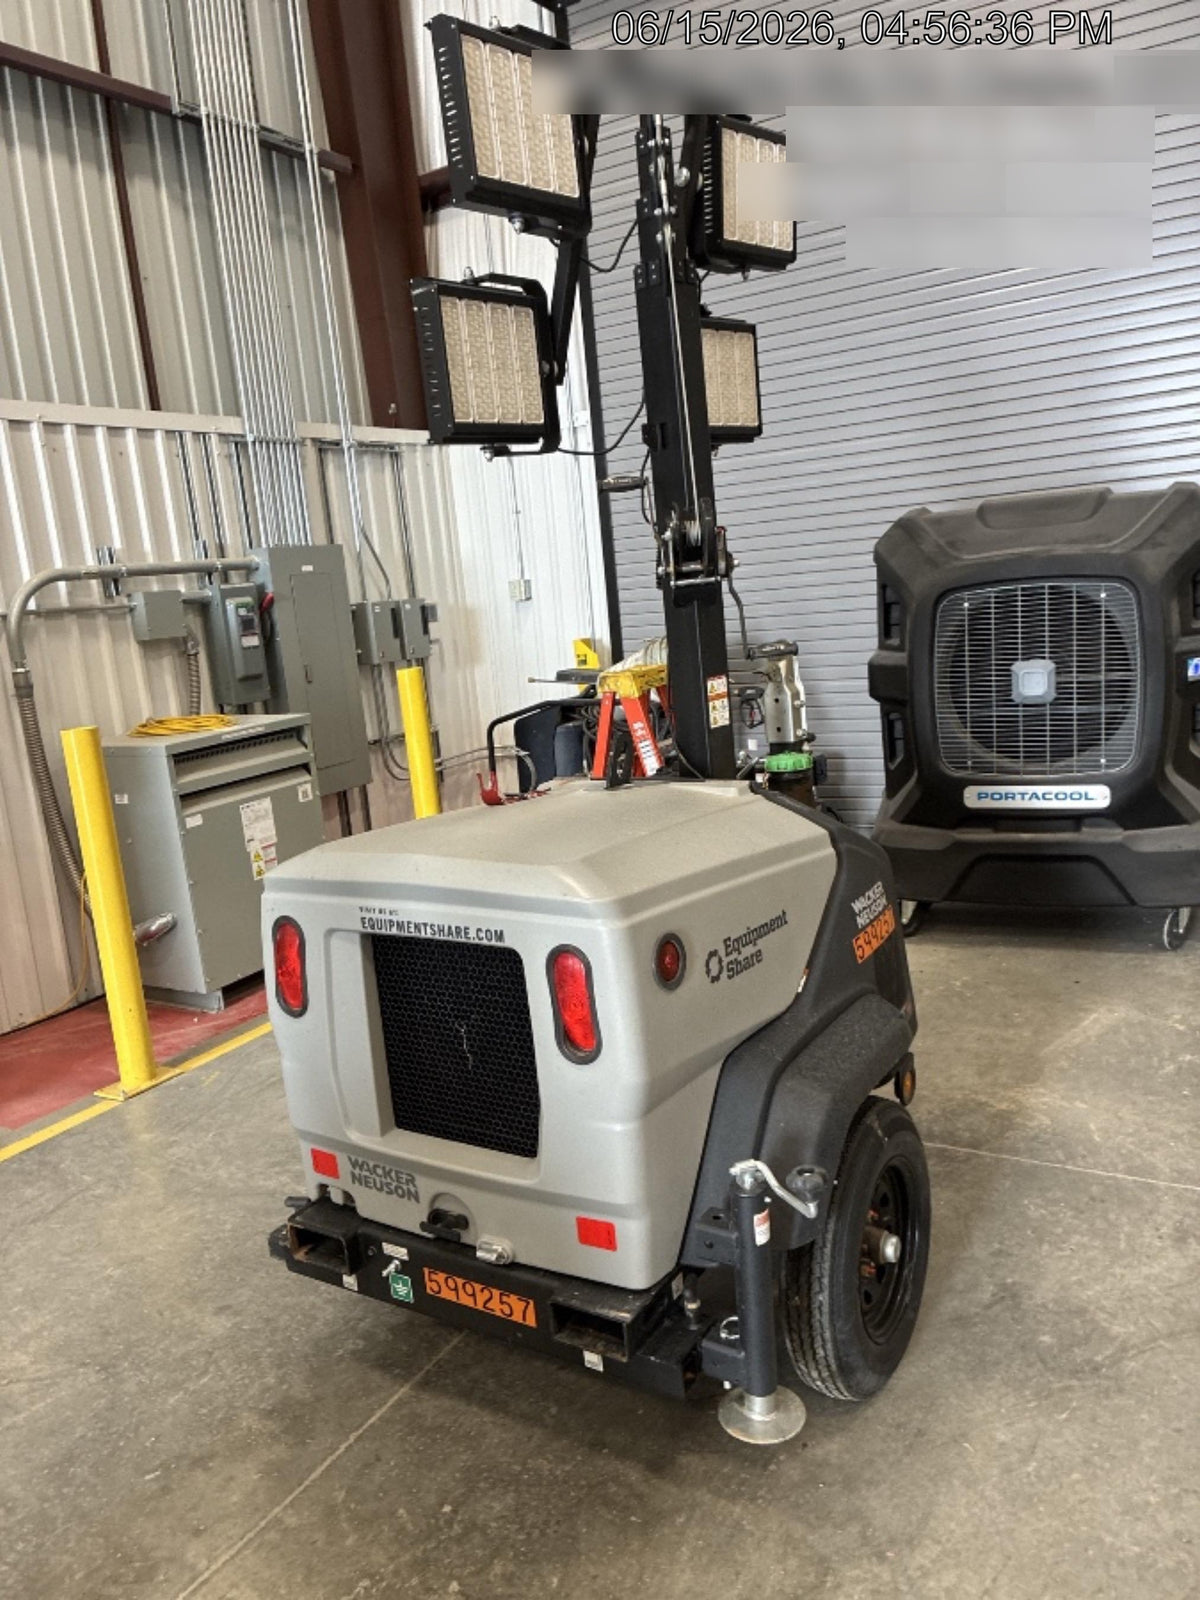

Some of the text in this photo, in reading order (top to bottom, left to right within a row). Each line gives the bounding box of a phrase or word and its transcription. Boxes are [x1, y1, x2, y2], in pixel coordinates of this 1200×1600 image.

[976, 790, 1095, 802] PORTACOOL
[360, 916, 505, 943] EQUIPMENTSHARE.COM
[723, 909, 788, 957] Equipment
[726, 949, 763, 980] Share
[347, 1155, 417, 1188] WACKER
[351, 1170, 420, 1204] NEUSON
[427, 1269, 530, 1323] 599257
